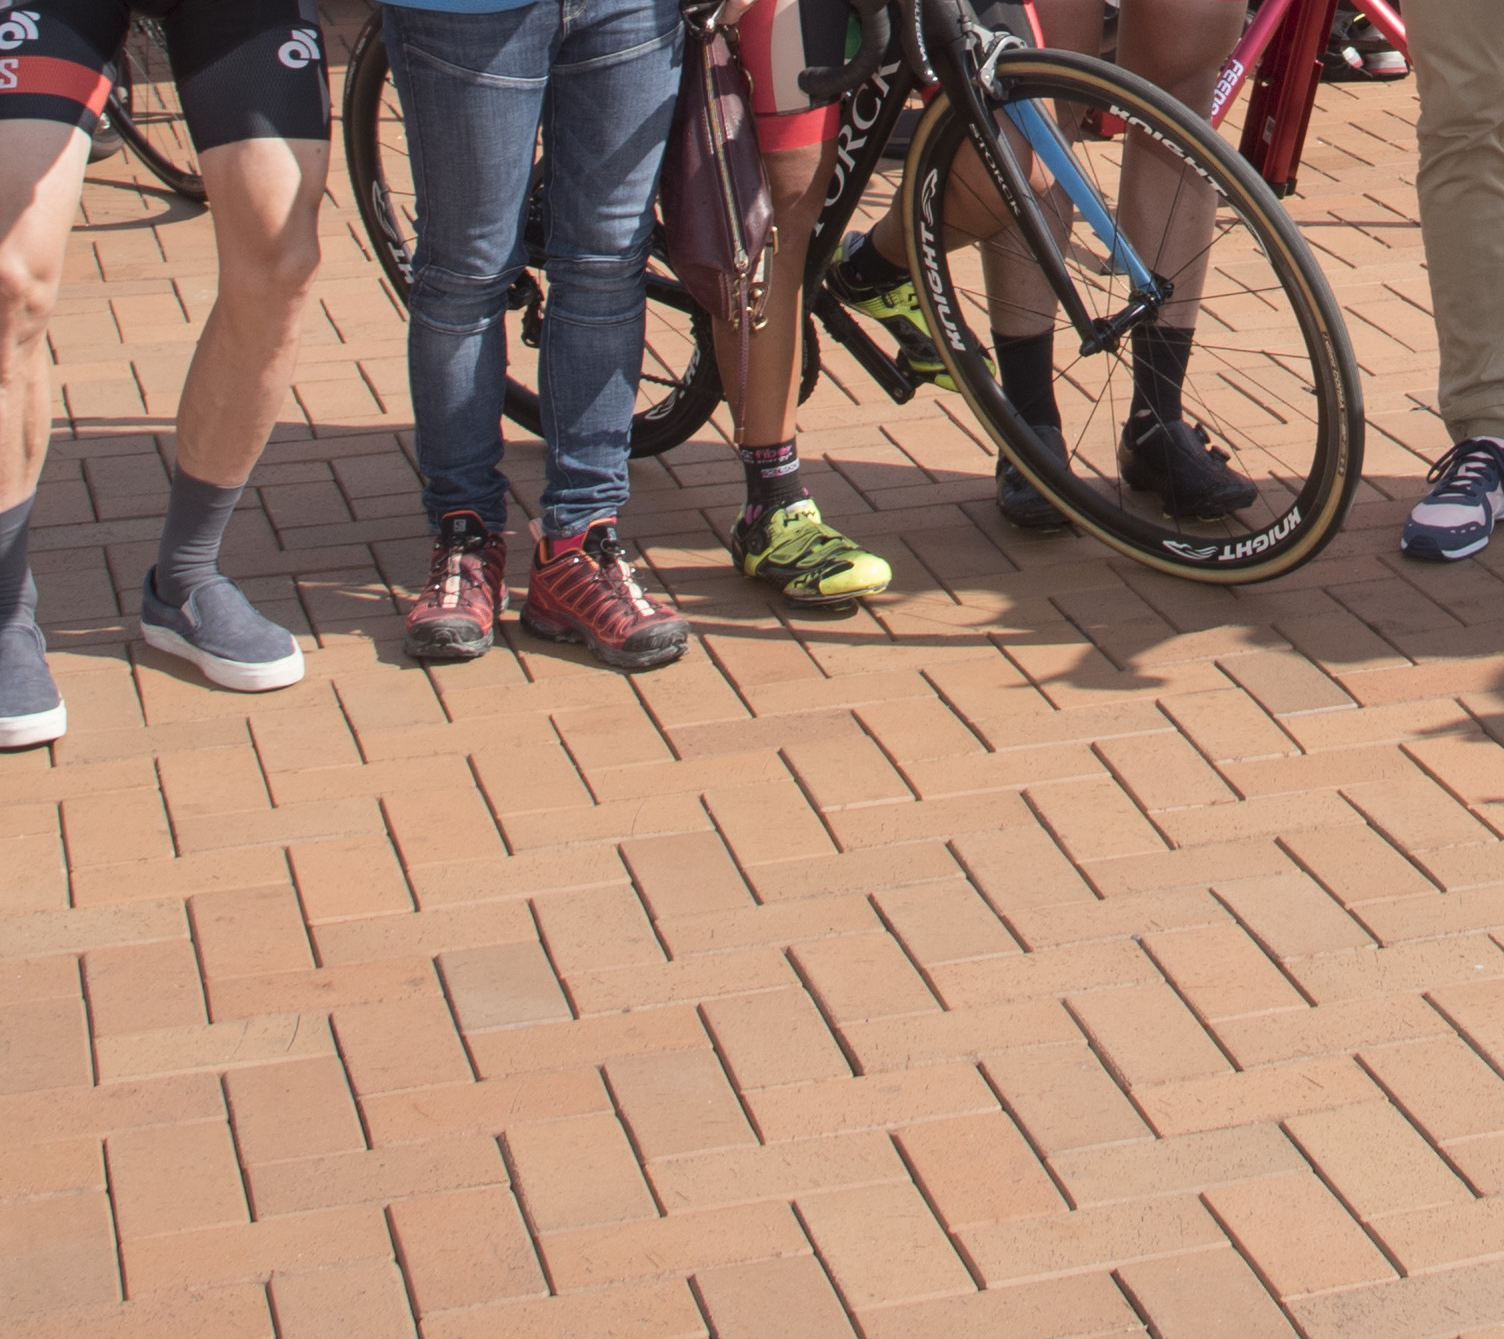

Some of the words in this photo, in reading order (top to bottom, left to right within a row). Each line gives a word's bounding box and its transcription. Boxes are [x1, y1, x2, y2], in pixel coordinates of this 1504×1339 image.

[969, 123, 1021, 216] STORCK
[1109, 104, 1228, 198] KNIGHT
[921, 222, 968, 353] KNIGHT
[1218, 506, 1303, 561] KNIGHT
